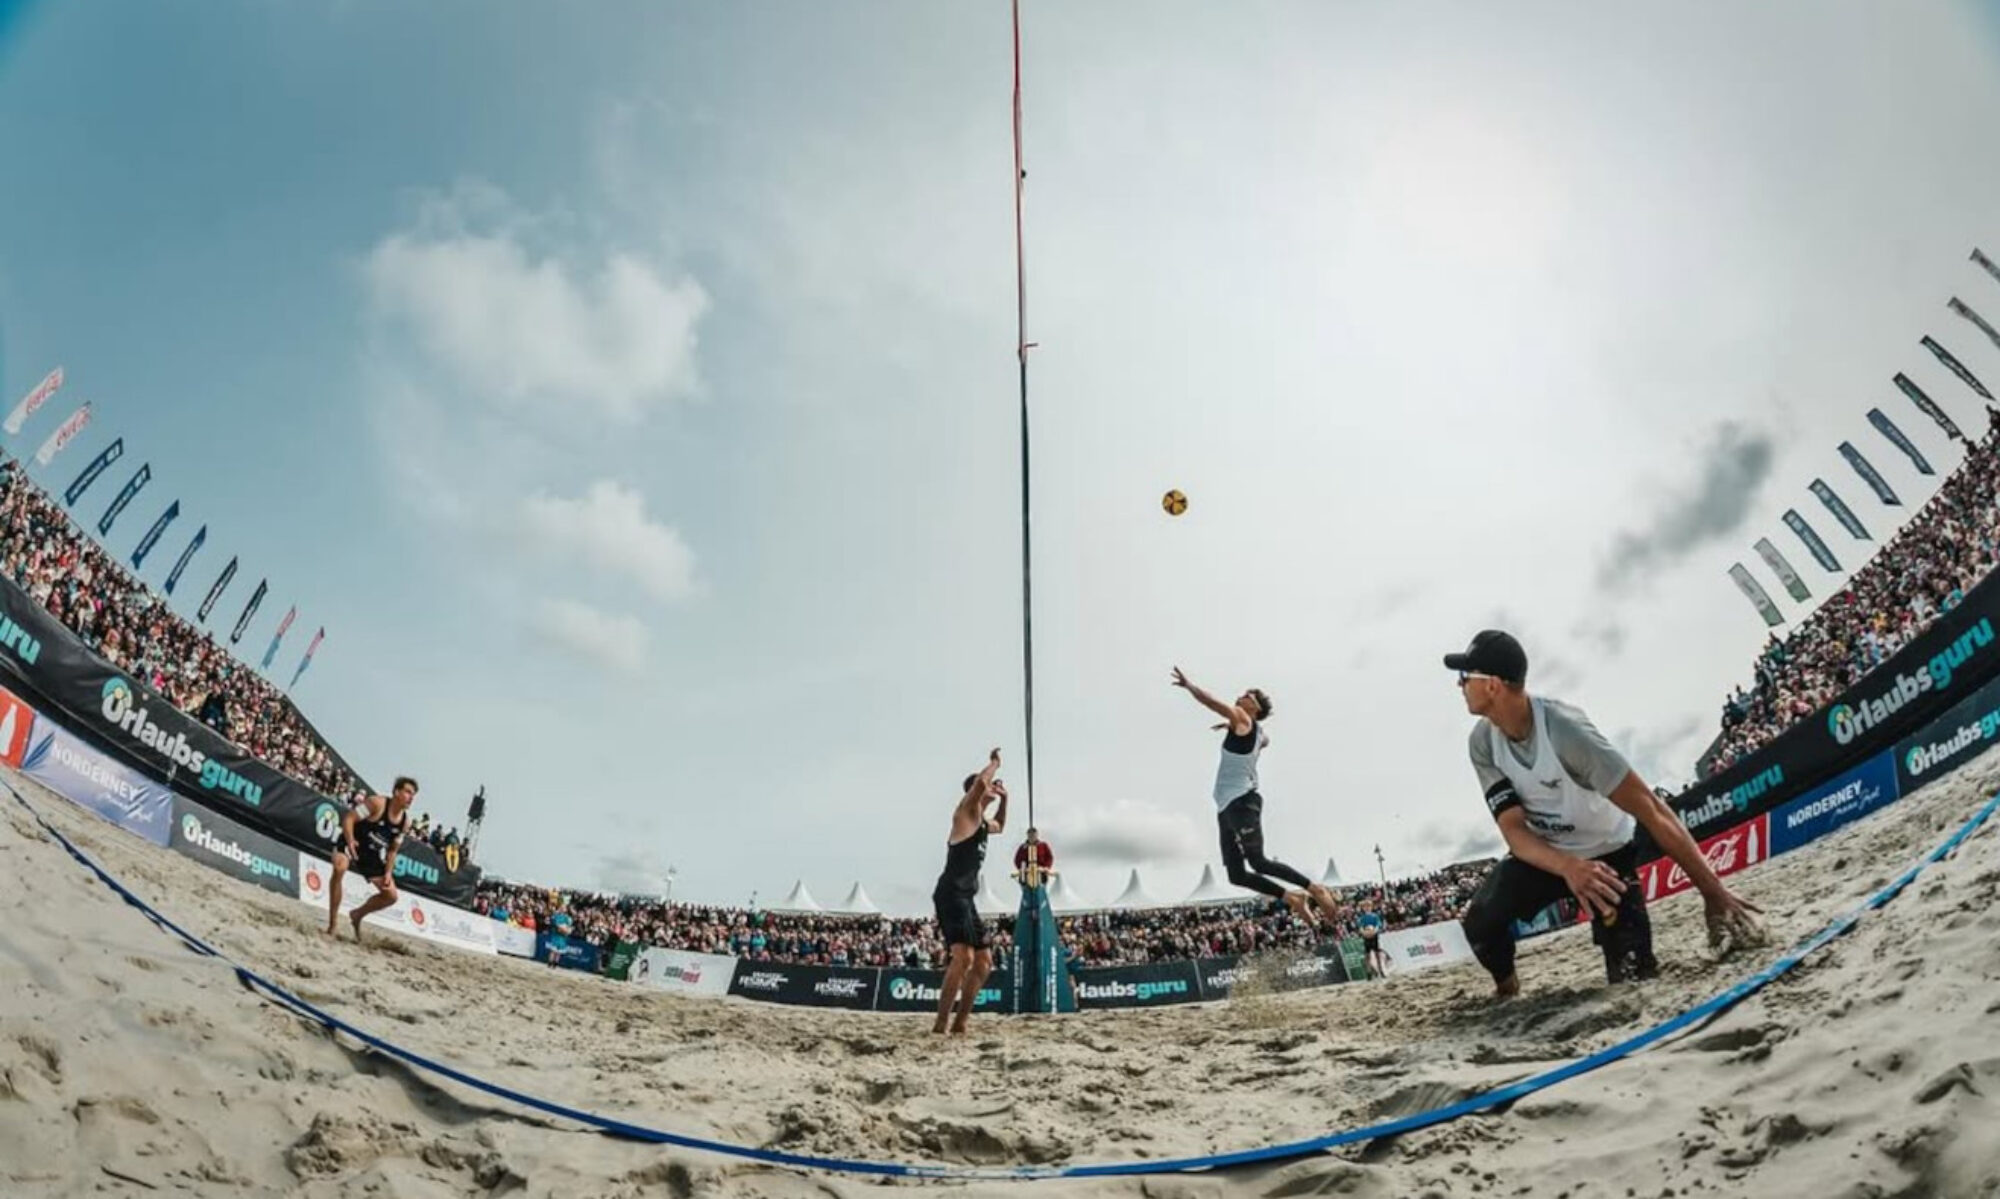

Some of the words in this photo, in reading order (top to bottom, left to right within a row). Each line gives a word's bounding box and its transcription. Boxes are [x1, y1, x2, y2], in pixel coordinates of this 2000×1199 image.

[1828, 618, 1995, 745] Urlaubsguru
[102, 677, 262, 805] Urlaubsguru
[182, 813, 291, 881] Urlaubsguru
[1787, 780, 1862, 829] NORDERNEY
